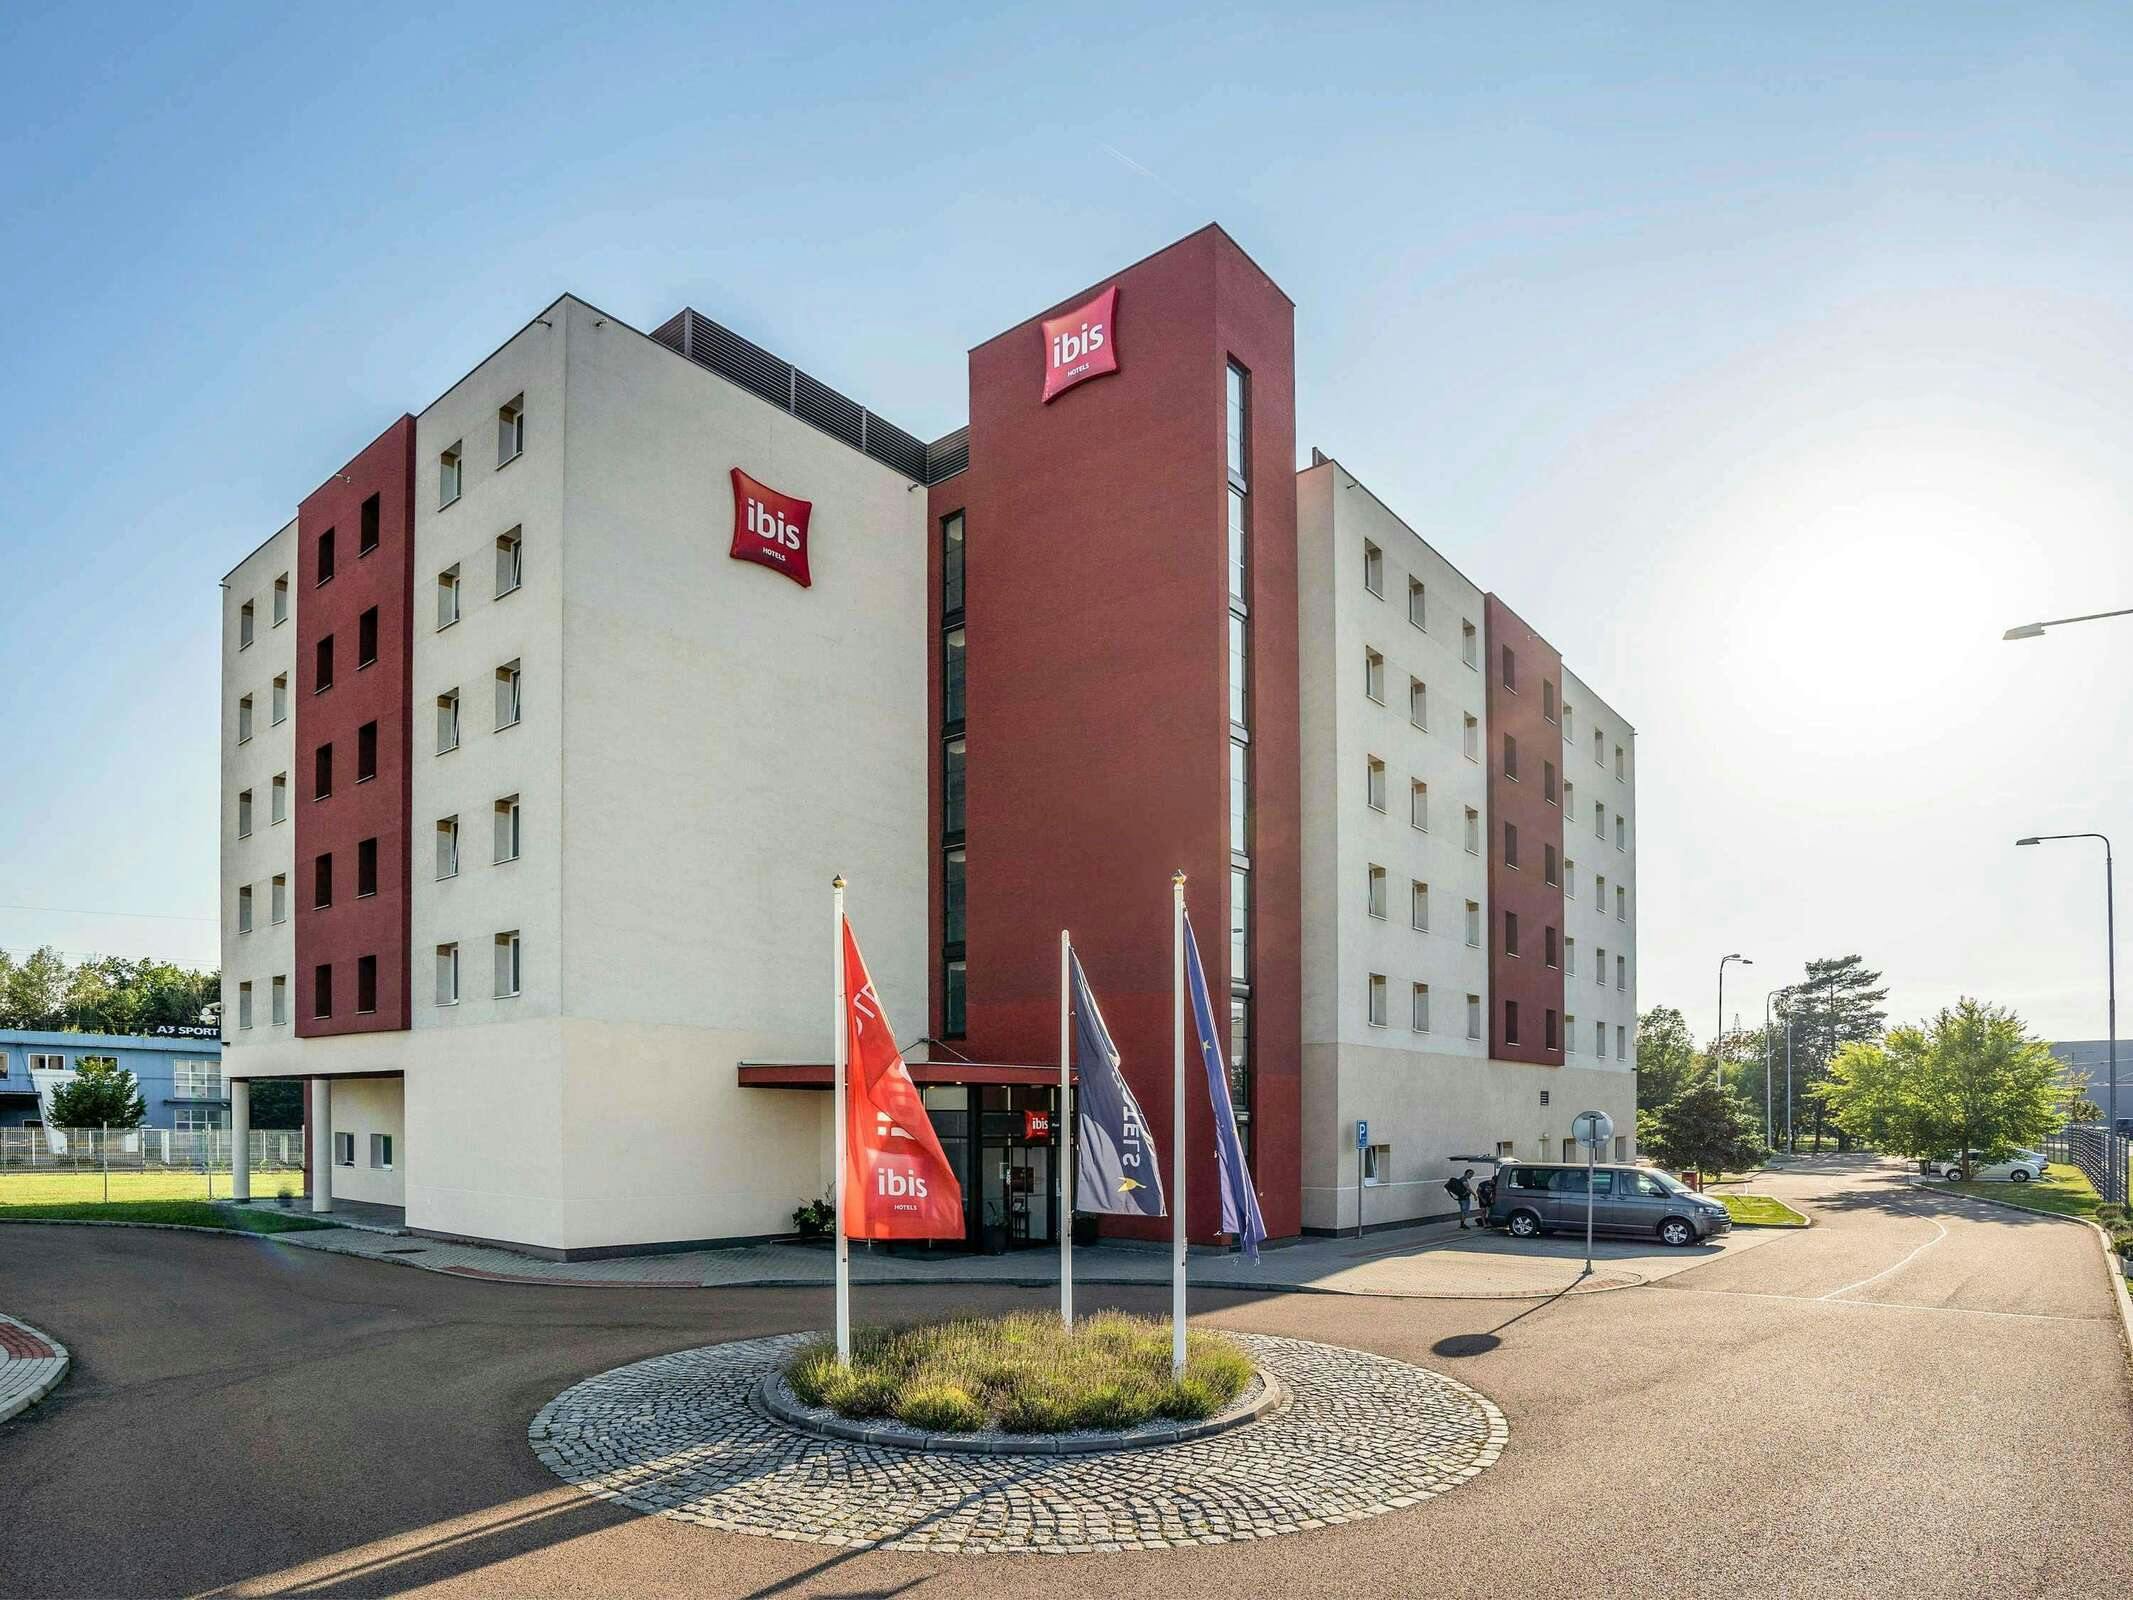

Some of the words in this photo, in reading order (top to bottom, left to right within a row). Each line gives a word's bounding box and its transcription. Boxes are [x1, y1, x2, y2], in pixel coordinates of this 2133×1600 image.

[1053, 322, 1104, 368] ibis
[1067, 362, 1090, 377] HOTELS
[746, 497, 800, 550] ibis
[762, 547, 786, 562] HOTELS
[156, 1025, 176, 1034] A3
[178, 1026, 219, 1036] SPORT
[1032, 1117, 1049, 1130] ibis
[1359, 1123, 1366, 1141] P
[877, 1167, 928, 1198] ibis
